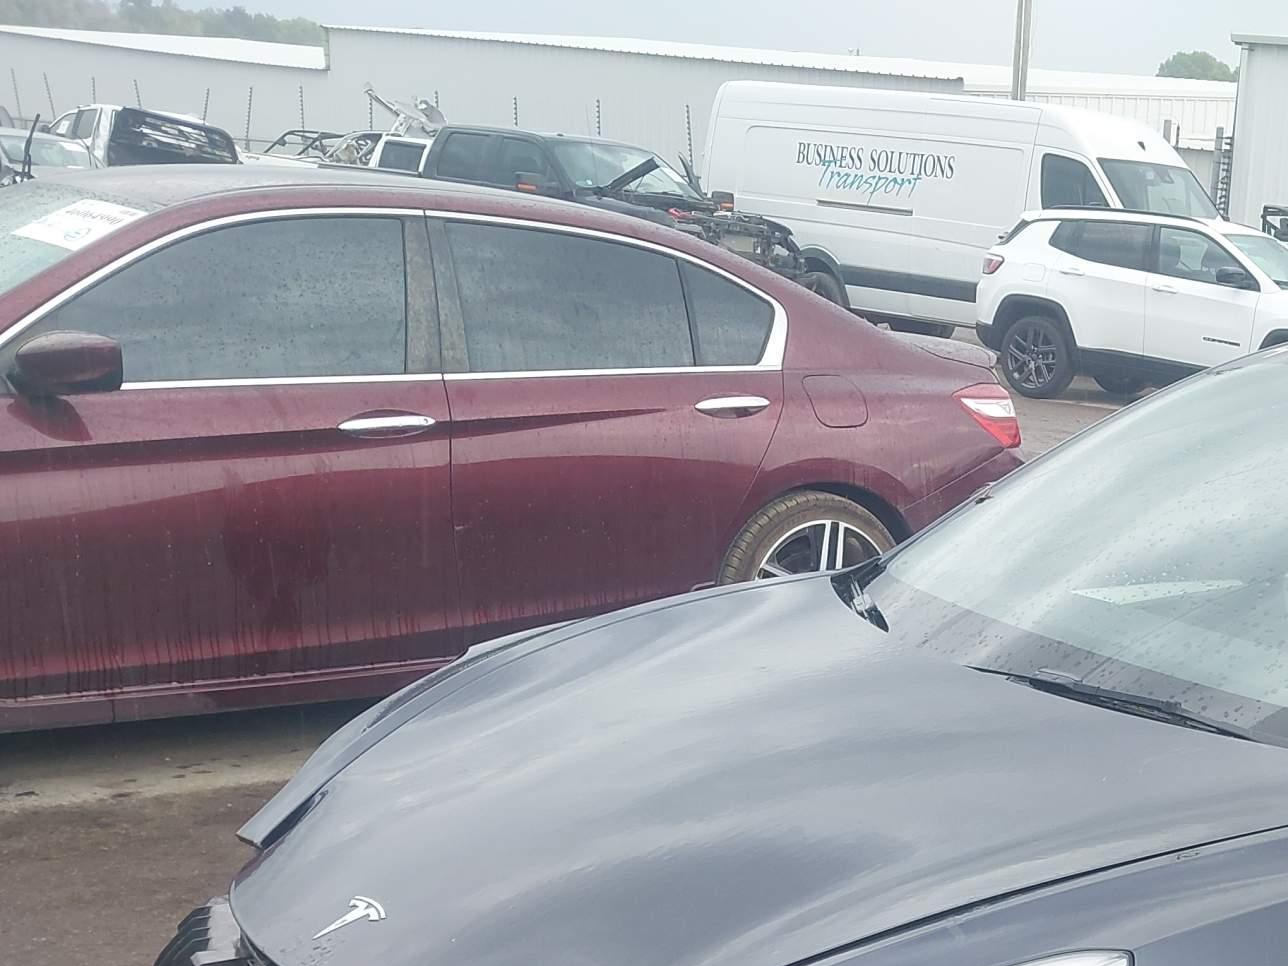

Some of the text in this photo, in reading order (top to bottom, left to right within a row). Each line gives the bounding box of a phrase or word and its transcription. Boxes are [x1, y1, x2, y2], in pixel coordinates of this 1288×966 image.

[796, 142, 955, 180] BUSINESS SOLUTIONS
[818, 159, 922, 204] Transport
